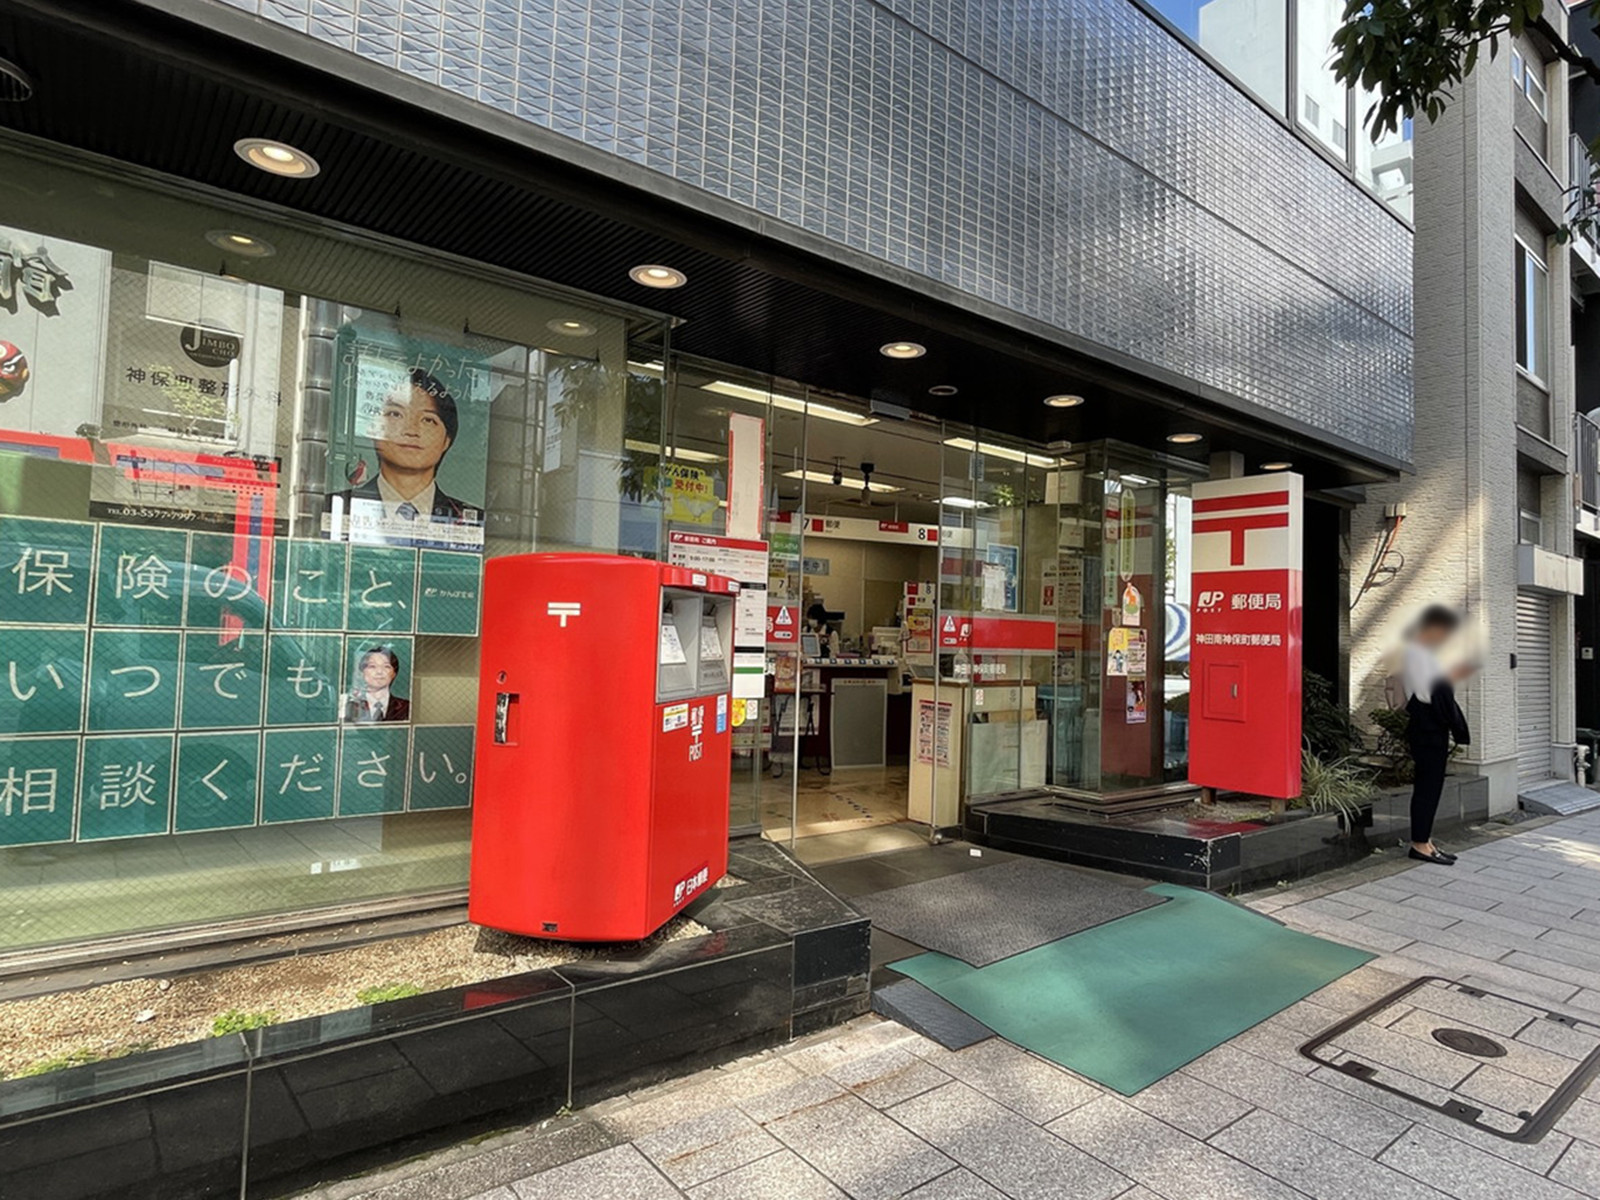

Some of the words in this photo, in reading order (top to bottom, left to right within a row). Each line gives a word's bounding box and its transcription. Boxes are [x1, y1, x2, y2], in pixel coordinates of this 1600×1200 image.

[918, 529, 926, 541] 8
[11, 546, 407, 609] 保険のこと、
[1230, 592, 1282, 611] 郵便局
[1195, 633, 1282, 647] 神田南神保町郵便局
[8, 657, 324, 701] いつでも
[0, 749, 468, 817] 相談ください。
